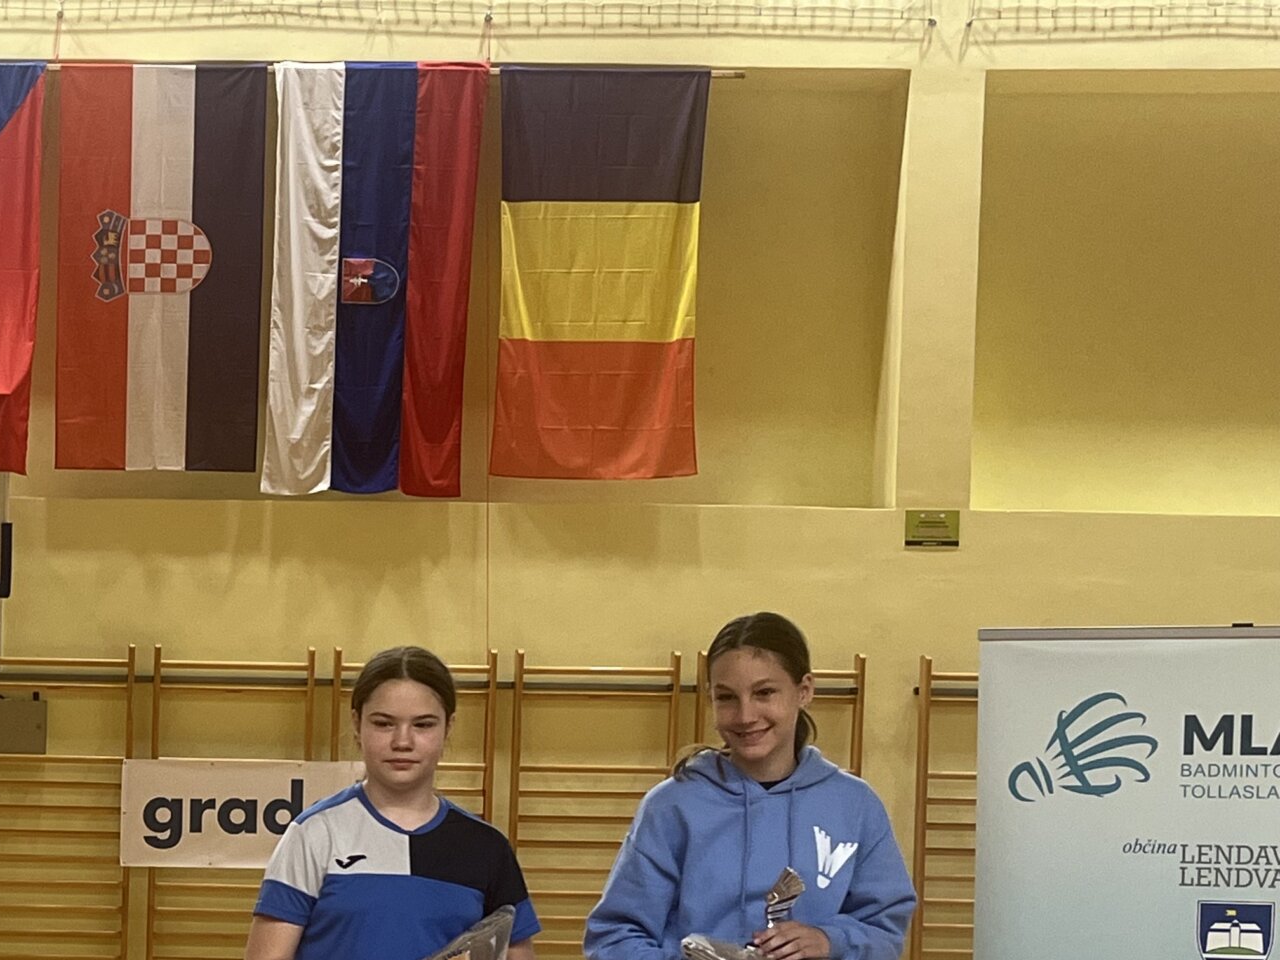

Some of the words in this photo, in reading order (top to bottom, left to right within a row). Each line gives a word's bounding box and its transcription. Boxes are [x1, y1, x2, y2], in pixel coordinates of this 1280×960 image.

[1183, 715, 1280, 755] ML
[1179, 784, 1280, 799] TOLLASLA
[1122, 838, 1177, 854] občina
